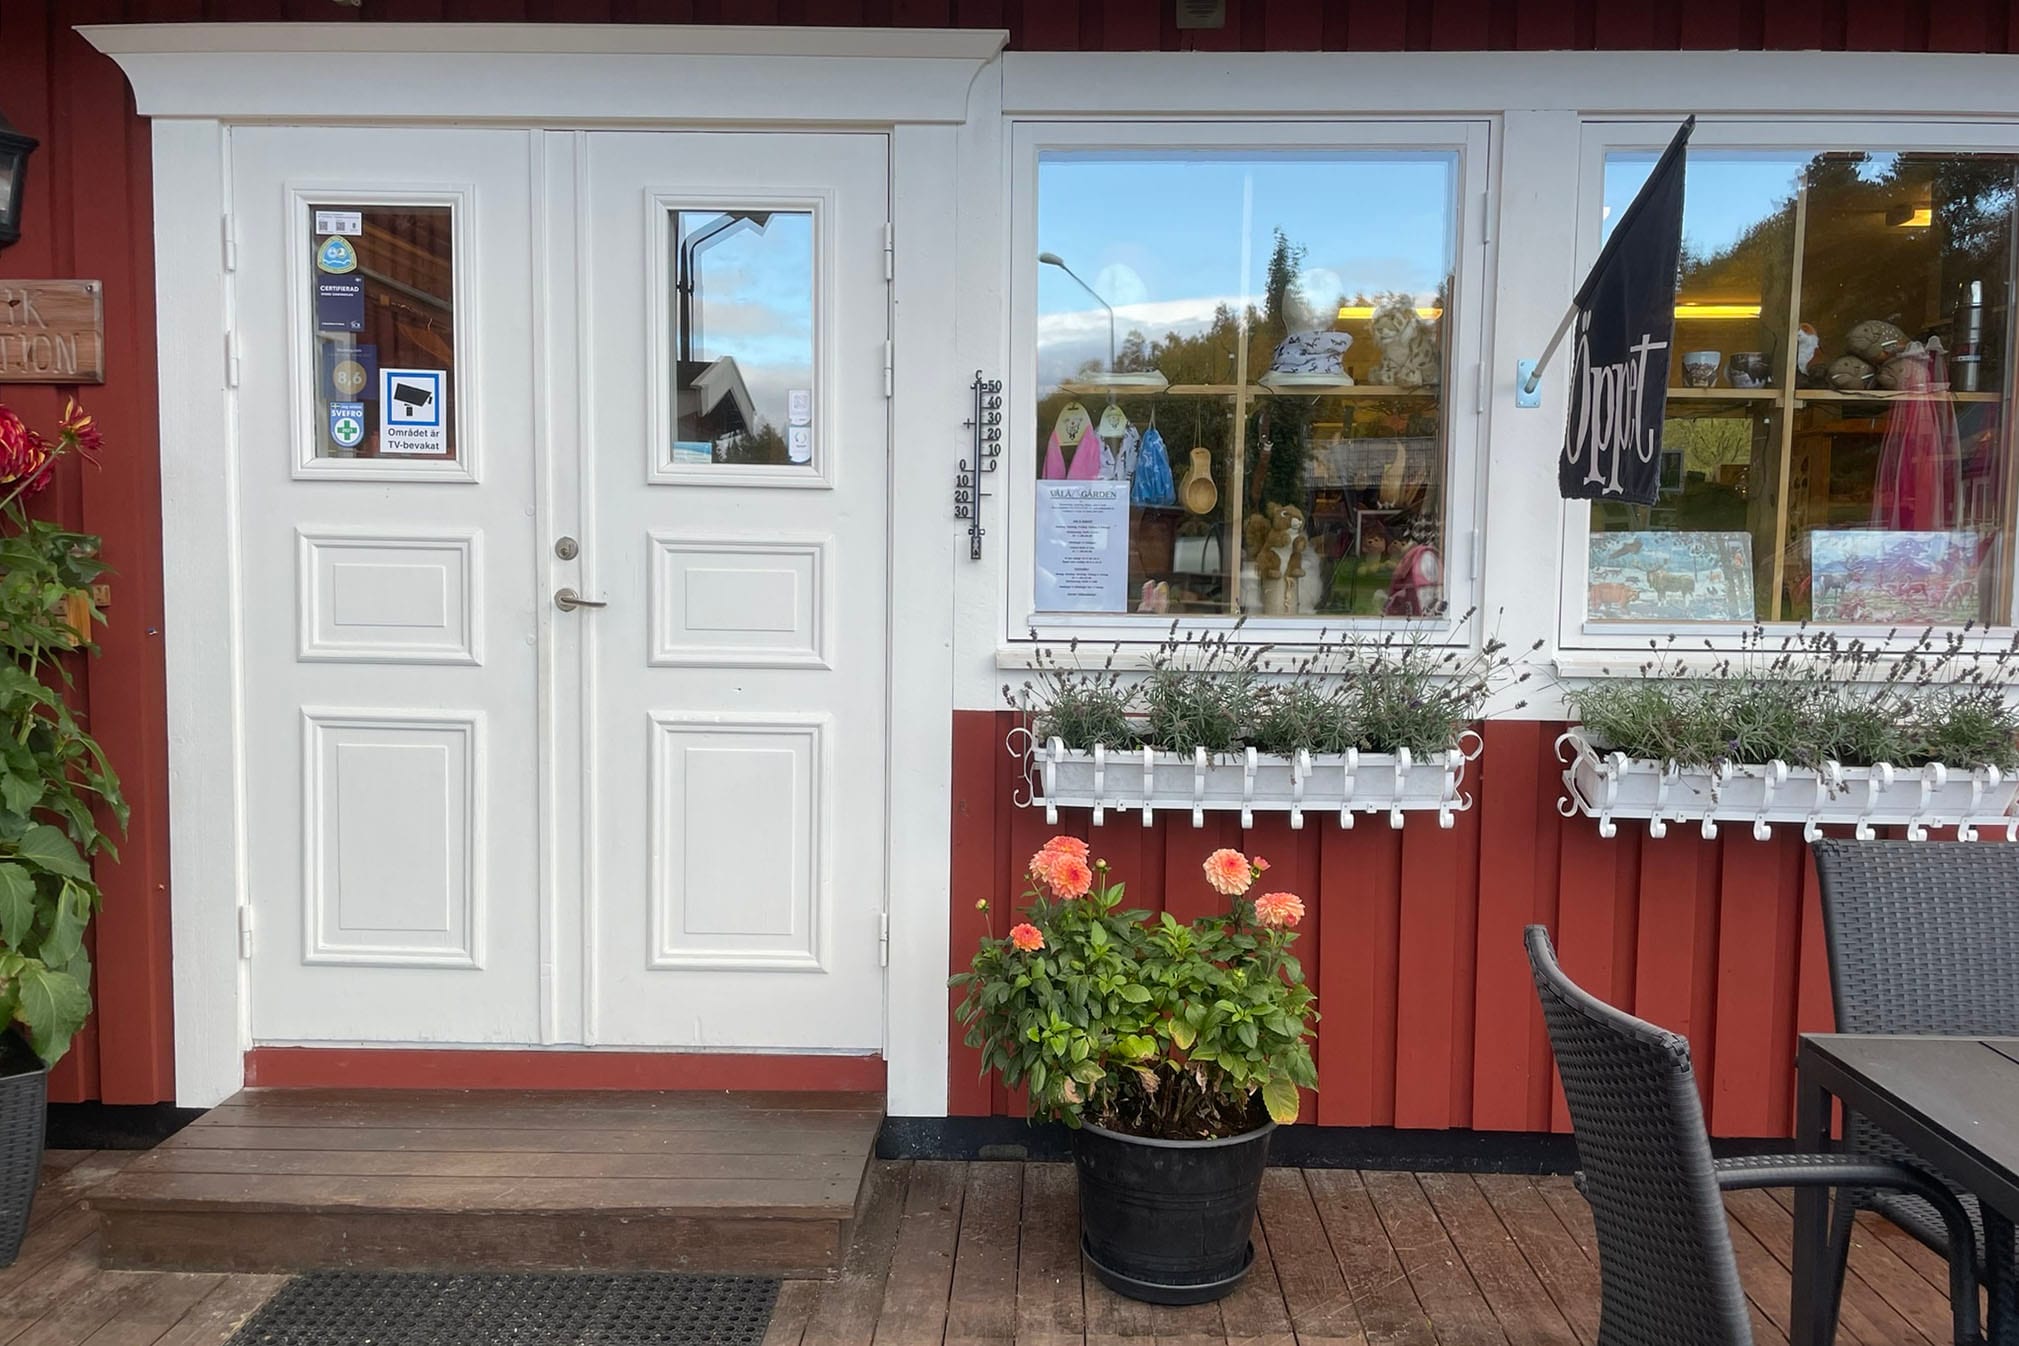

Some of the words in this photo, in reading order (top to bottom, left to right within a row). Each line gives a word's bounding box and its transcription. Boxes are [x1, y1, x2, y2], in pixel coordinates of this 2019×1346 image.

[987, 380, 1002, 392] 50
[987, 396, 1002, 408] 40
[1566, 310, 1668, 496] Öppet
[987, 412, 1002, 424] 30
[388, 428, 427, 437] Området
[987, 428, 1002, 440] 20
[388, 440, 440, 450] TV-bevakat
[988, 443, 1001, 455] 10
[959, 459, 966, 471] 0
[990, 459, 997, 471] 0
[956, 475, 969, 487] 10
[954, 491, 969, 503] 20
[1080, 488, 1117, 498] GÅRDEN
[954, 506, 969, 518] 30
